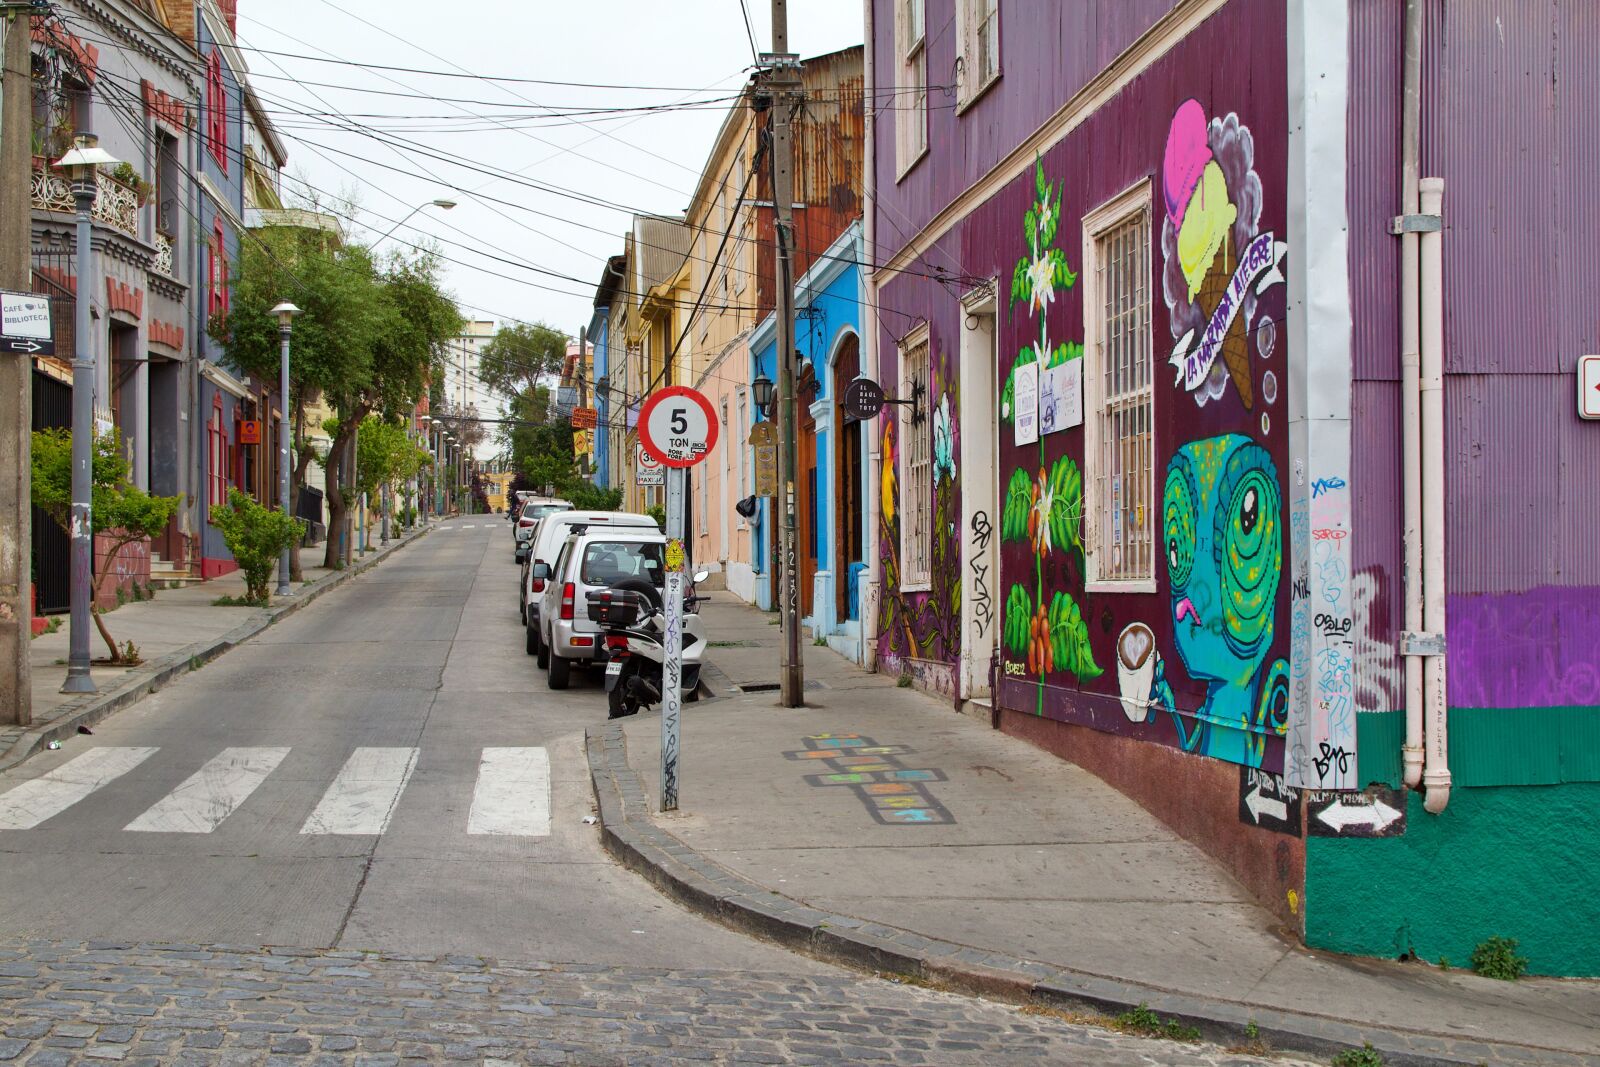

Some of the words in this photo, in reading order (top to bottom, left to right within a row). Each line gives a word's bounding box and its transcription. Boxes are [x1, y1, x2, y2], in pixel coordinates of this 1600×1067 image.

[1187, 356, 1197, 383] LA
[1197, 292, 1234, 373] MORADA
[1233, 235, 1272, 301] ALEGRE
[4, 315, 49, 324] BIBLIOTECA
[670, 408, 688, 435] 5
[669, 438, 689, 448] TON
